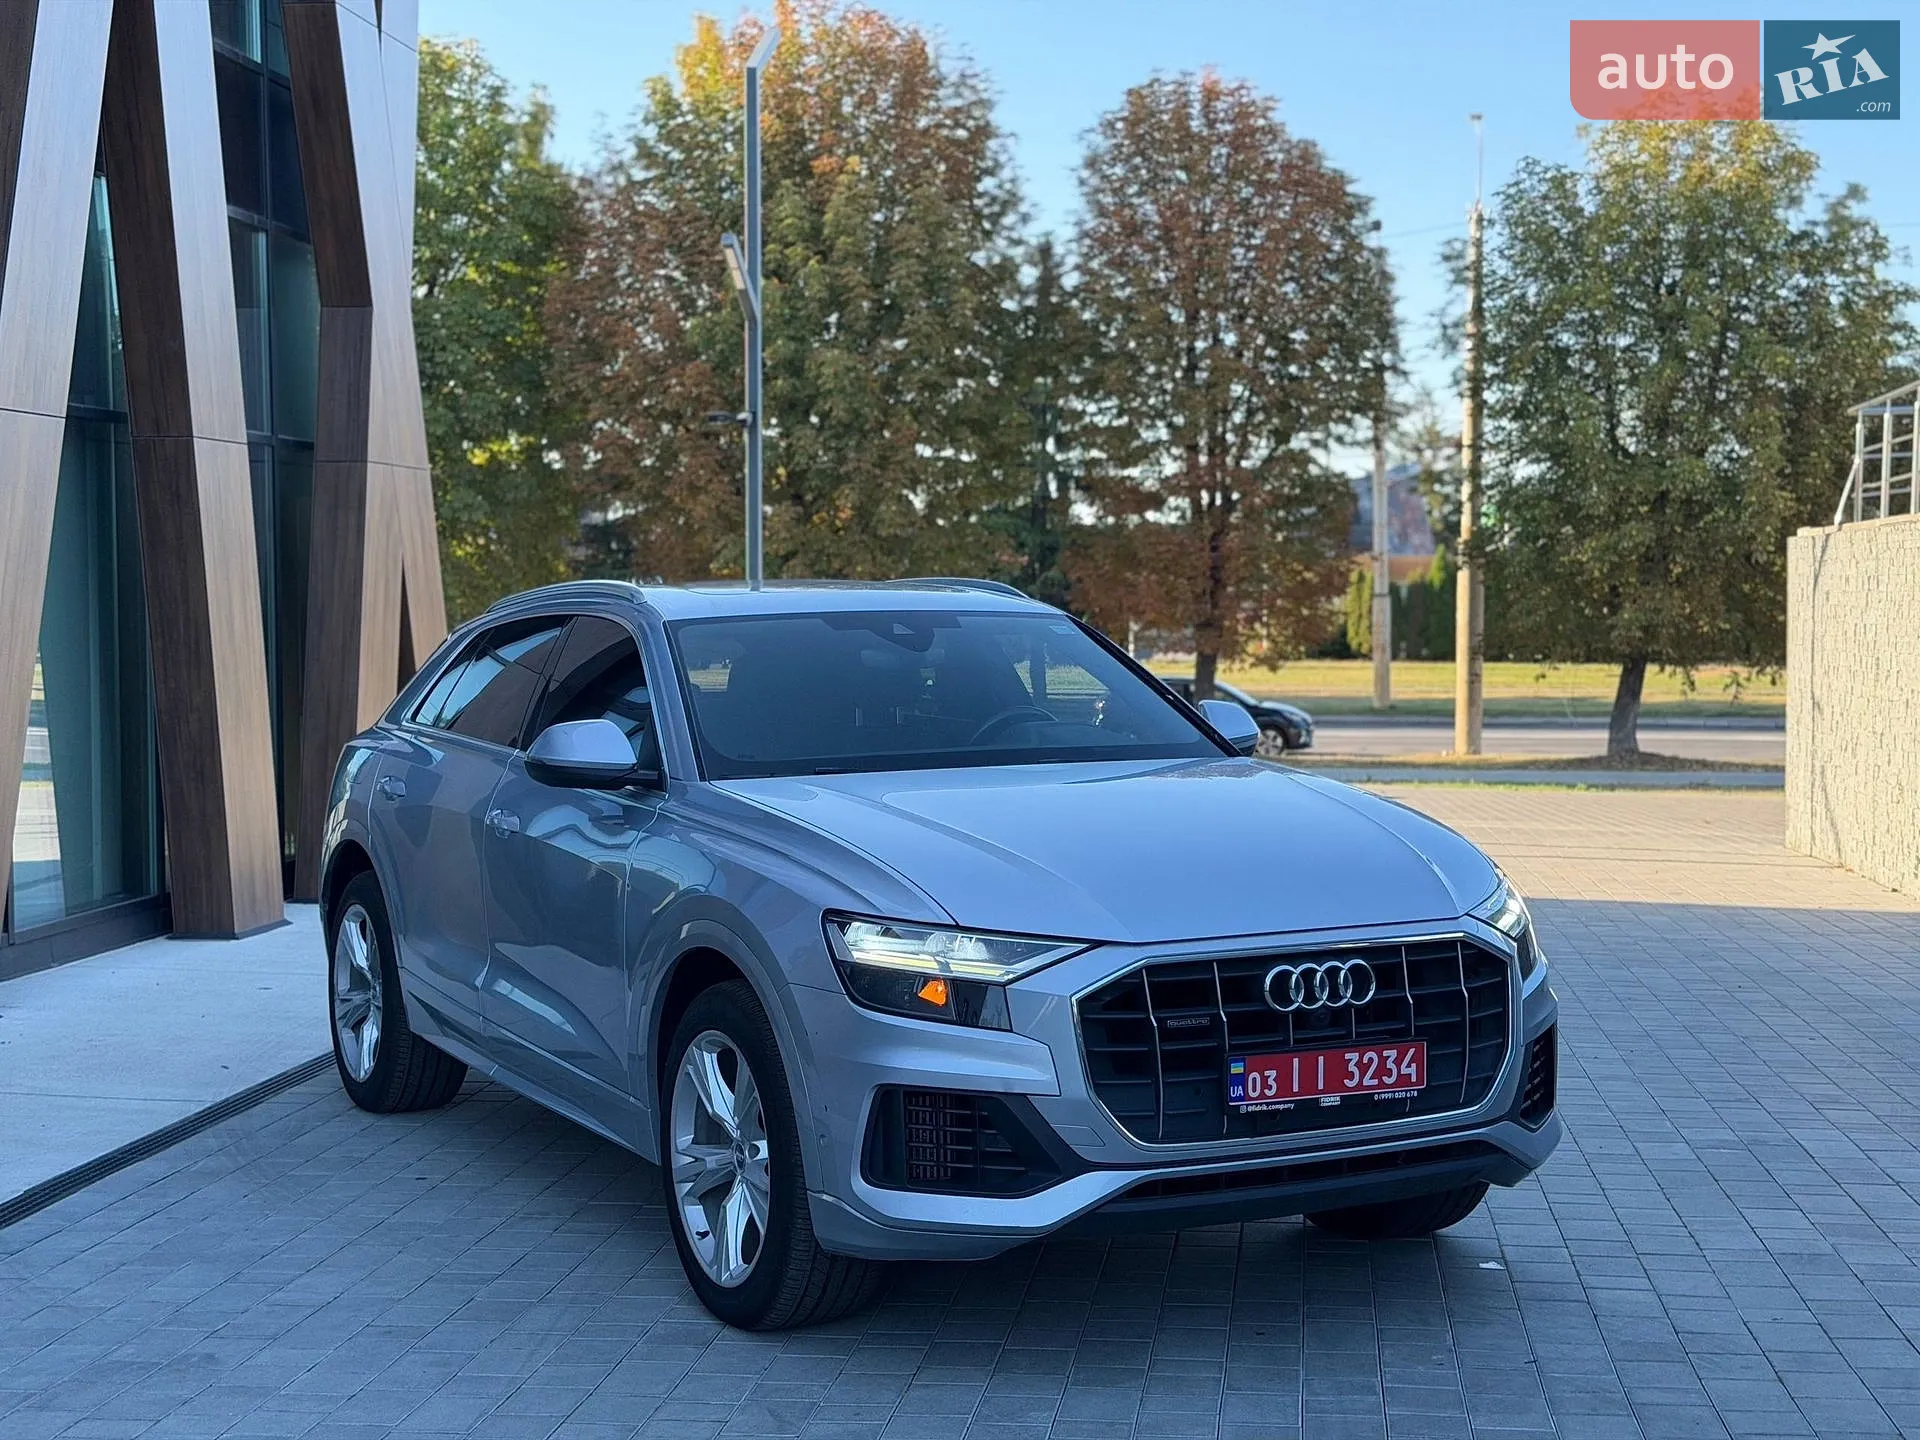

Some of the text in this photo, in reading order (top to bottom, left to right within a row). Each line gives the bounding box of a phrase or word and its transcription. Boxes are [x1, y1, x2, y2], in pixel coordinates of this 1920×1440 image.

[1248, 1070, 1277, 1098] 03
[1343, 1047, 1417, 1087] 3234
[1230, 1085, 1244, 1098] UA
